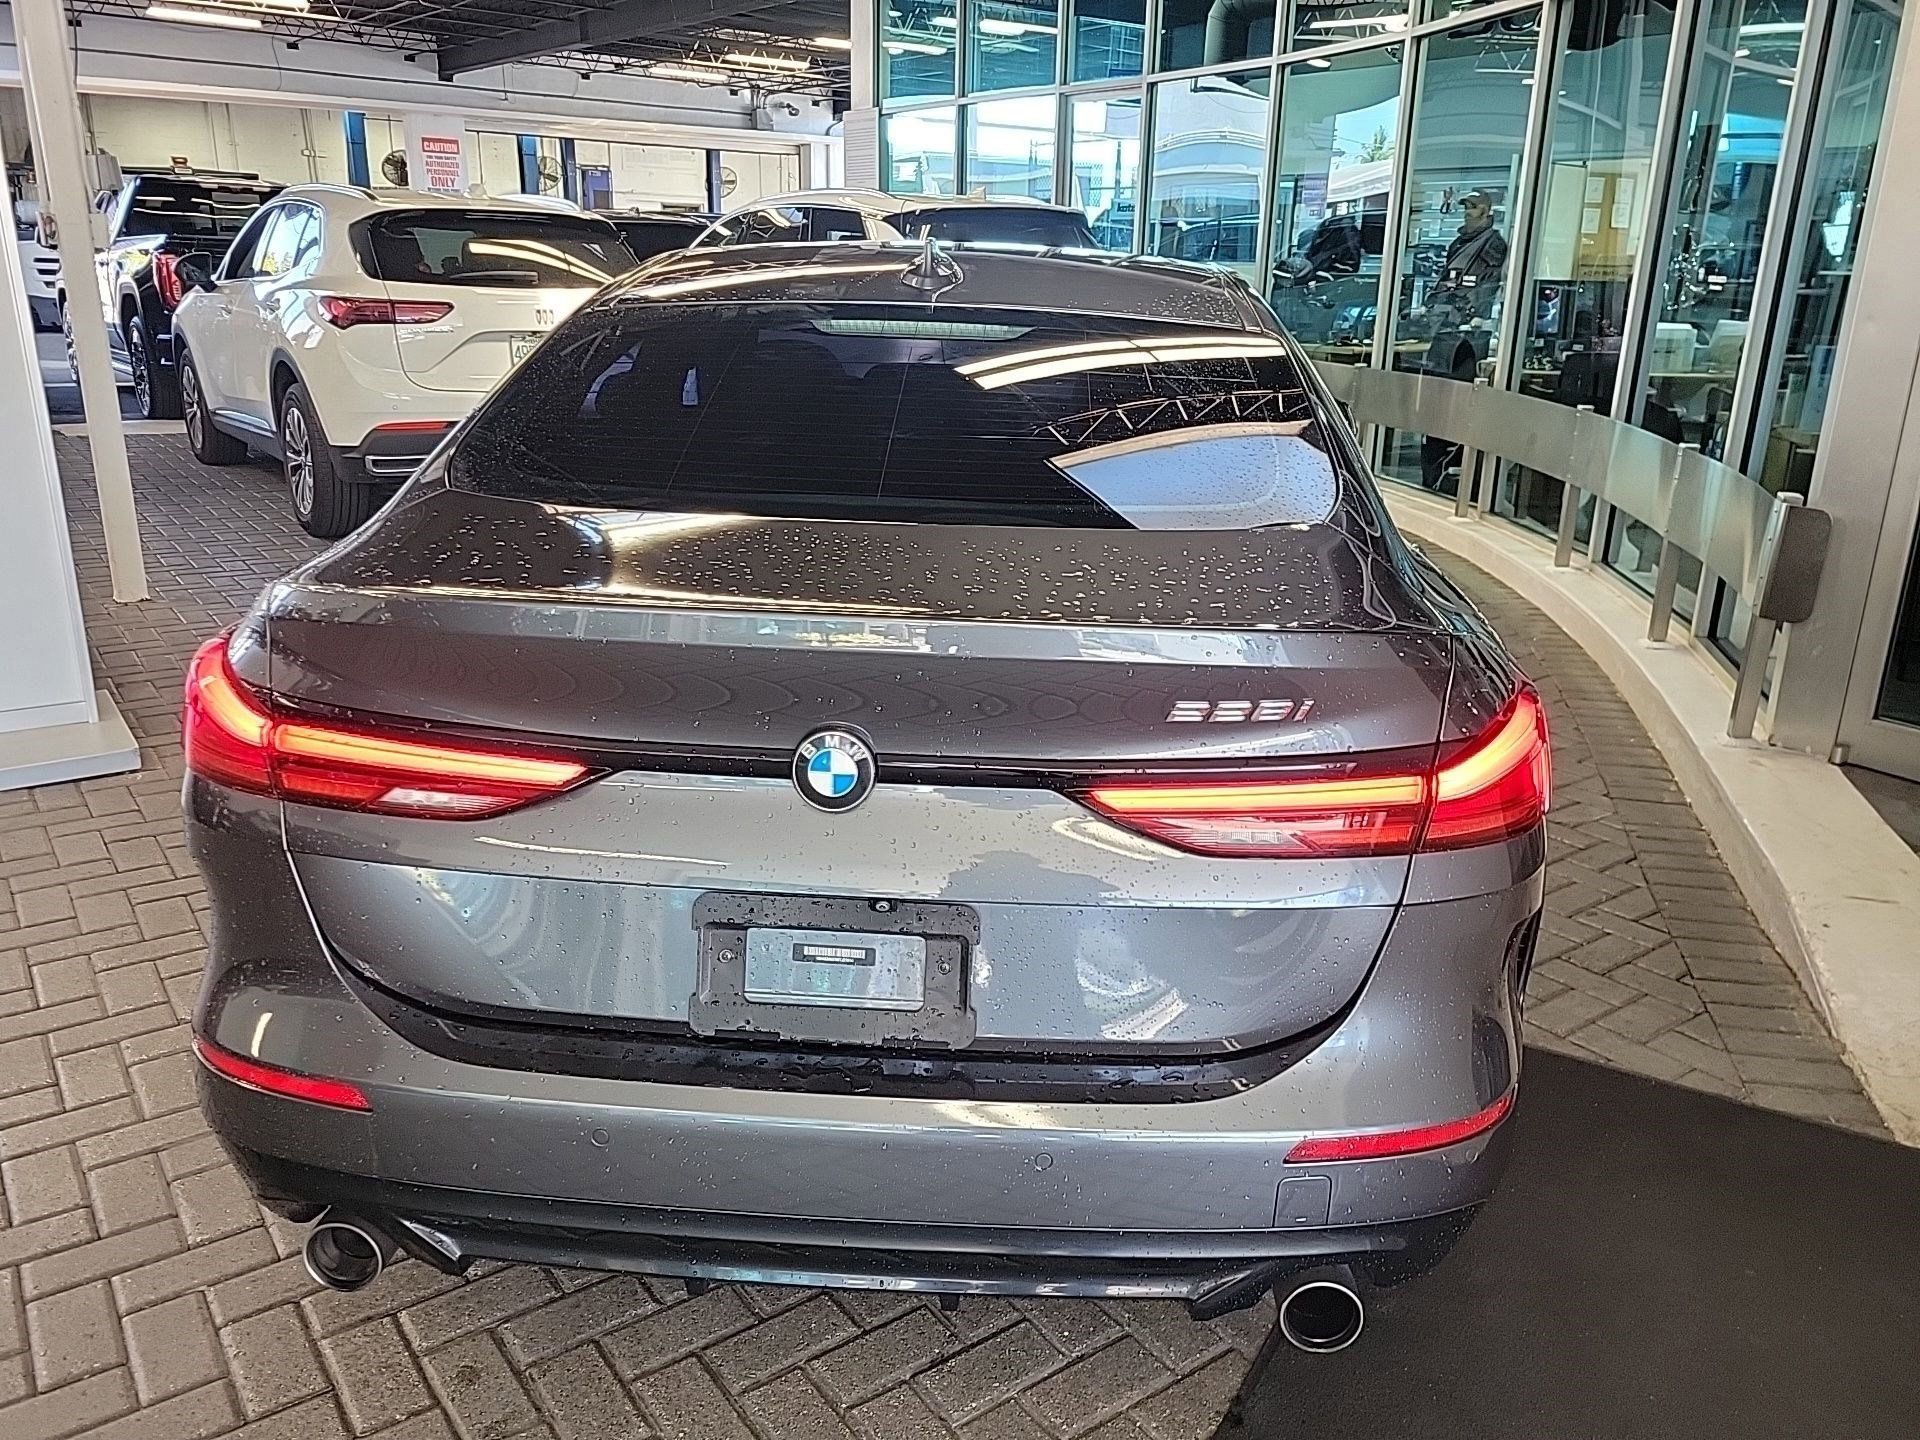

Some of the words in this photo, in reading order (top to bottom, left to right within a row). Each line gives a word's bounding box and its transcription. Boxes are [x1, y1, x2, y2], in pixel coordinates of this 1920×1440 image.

[423, 141, 458, 153] CAUTION
[425, 160, 460, 169] AUTHORIZED
[426, 168, 460, 177] PERSONNEL
[431, 176, 456, 188] ONLY
[800, 735, 868, 762] BMW
